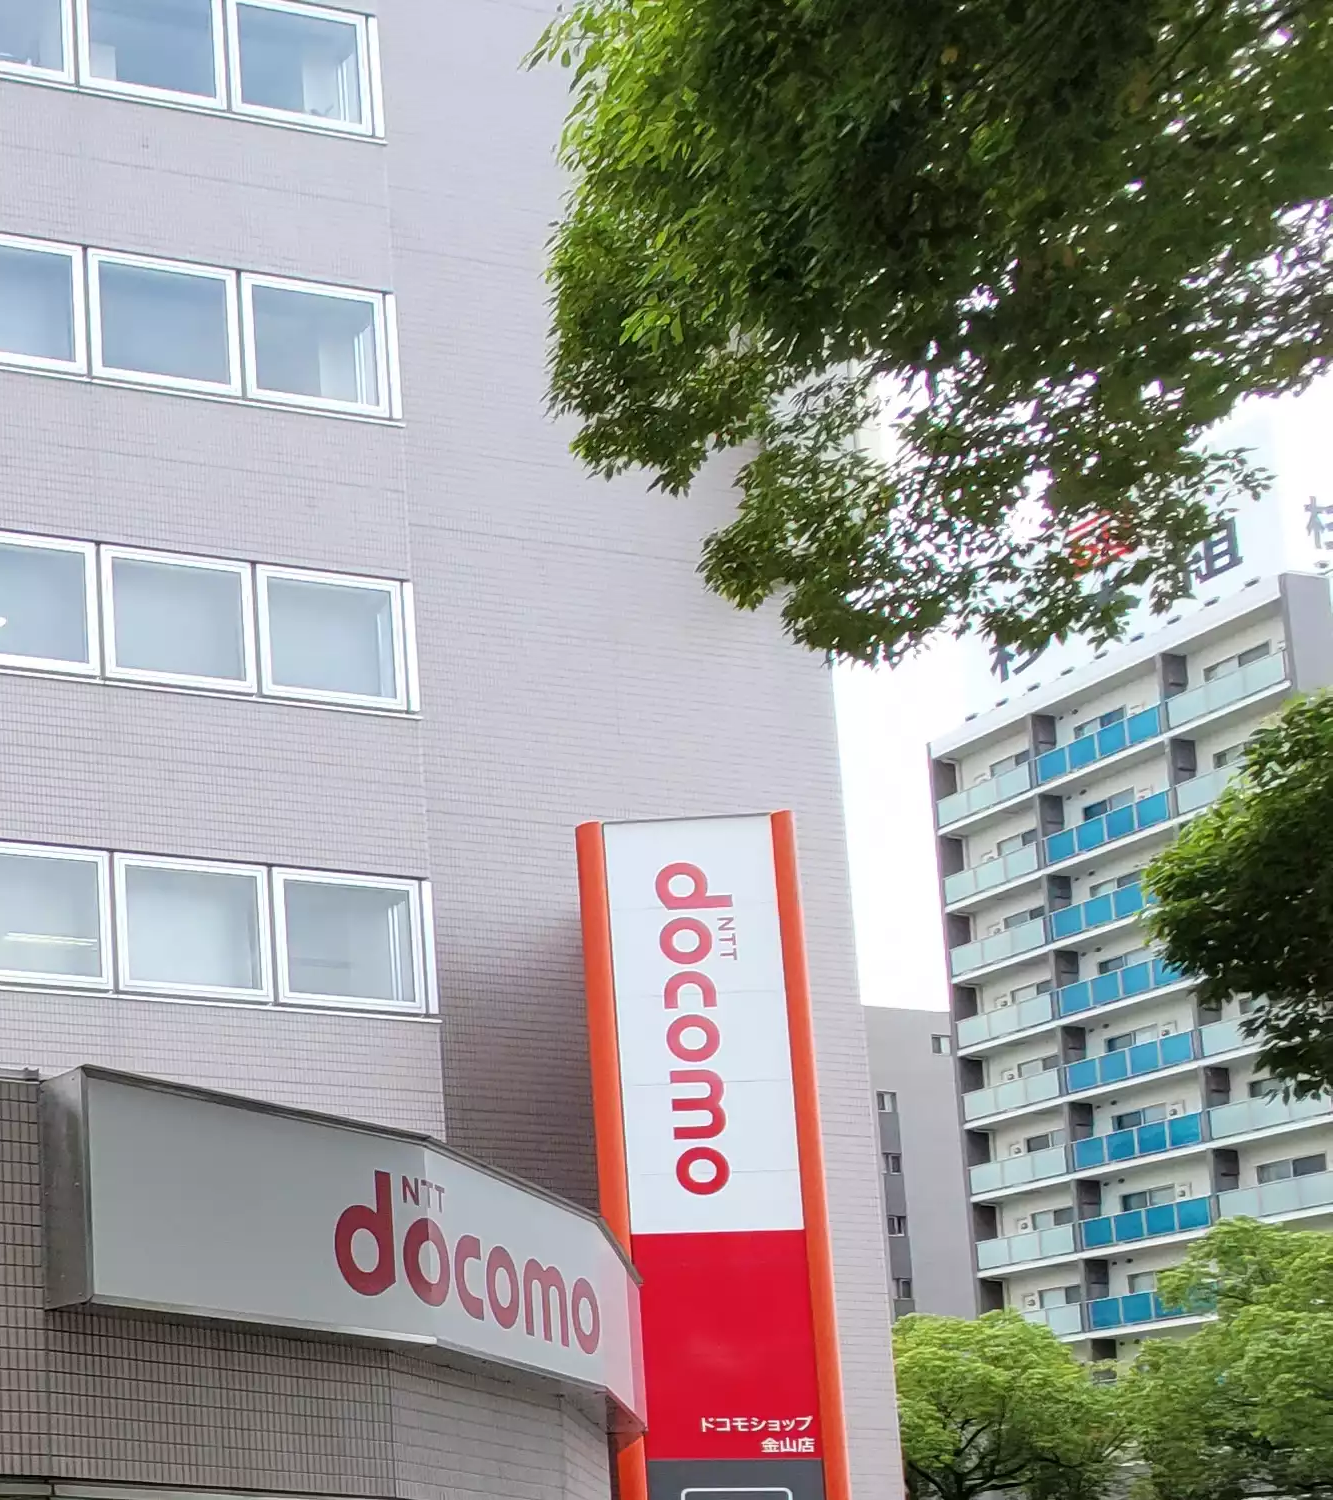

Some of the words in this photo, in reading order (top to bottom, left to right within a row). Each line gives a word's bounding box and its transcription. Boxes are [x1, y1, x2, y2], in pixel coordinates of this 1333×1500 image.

[717, 916, 738, 960] NTT
[655, 862, 733, 1195] docomo
[401, 1175, 445, 1213] NTT
[335, 1169, 601, 1355] docomo
[700, 1415, 813, 1432] ドコモショップ
[760, 1437, 815, 1453] 金山店
